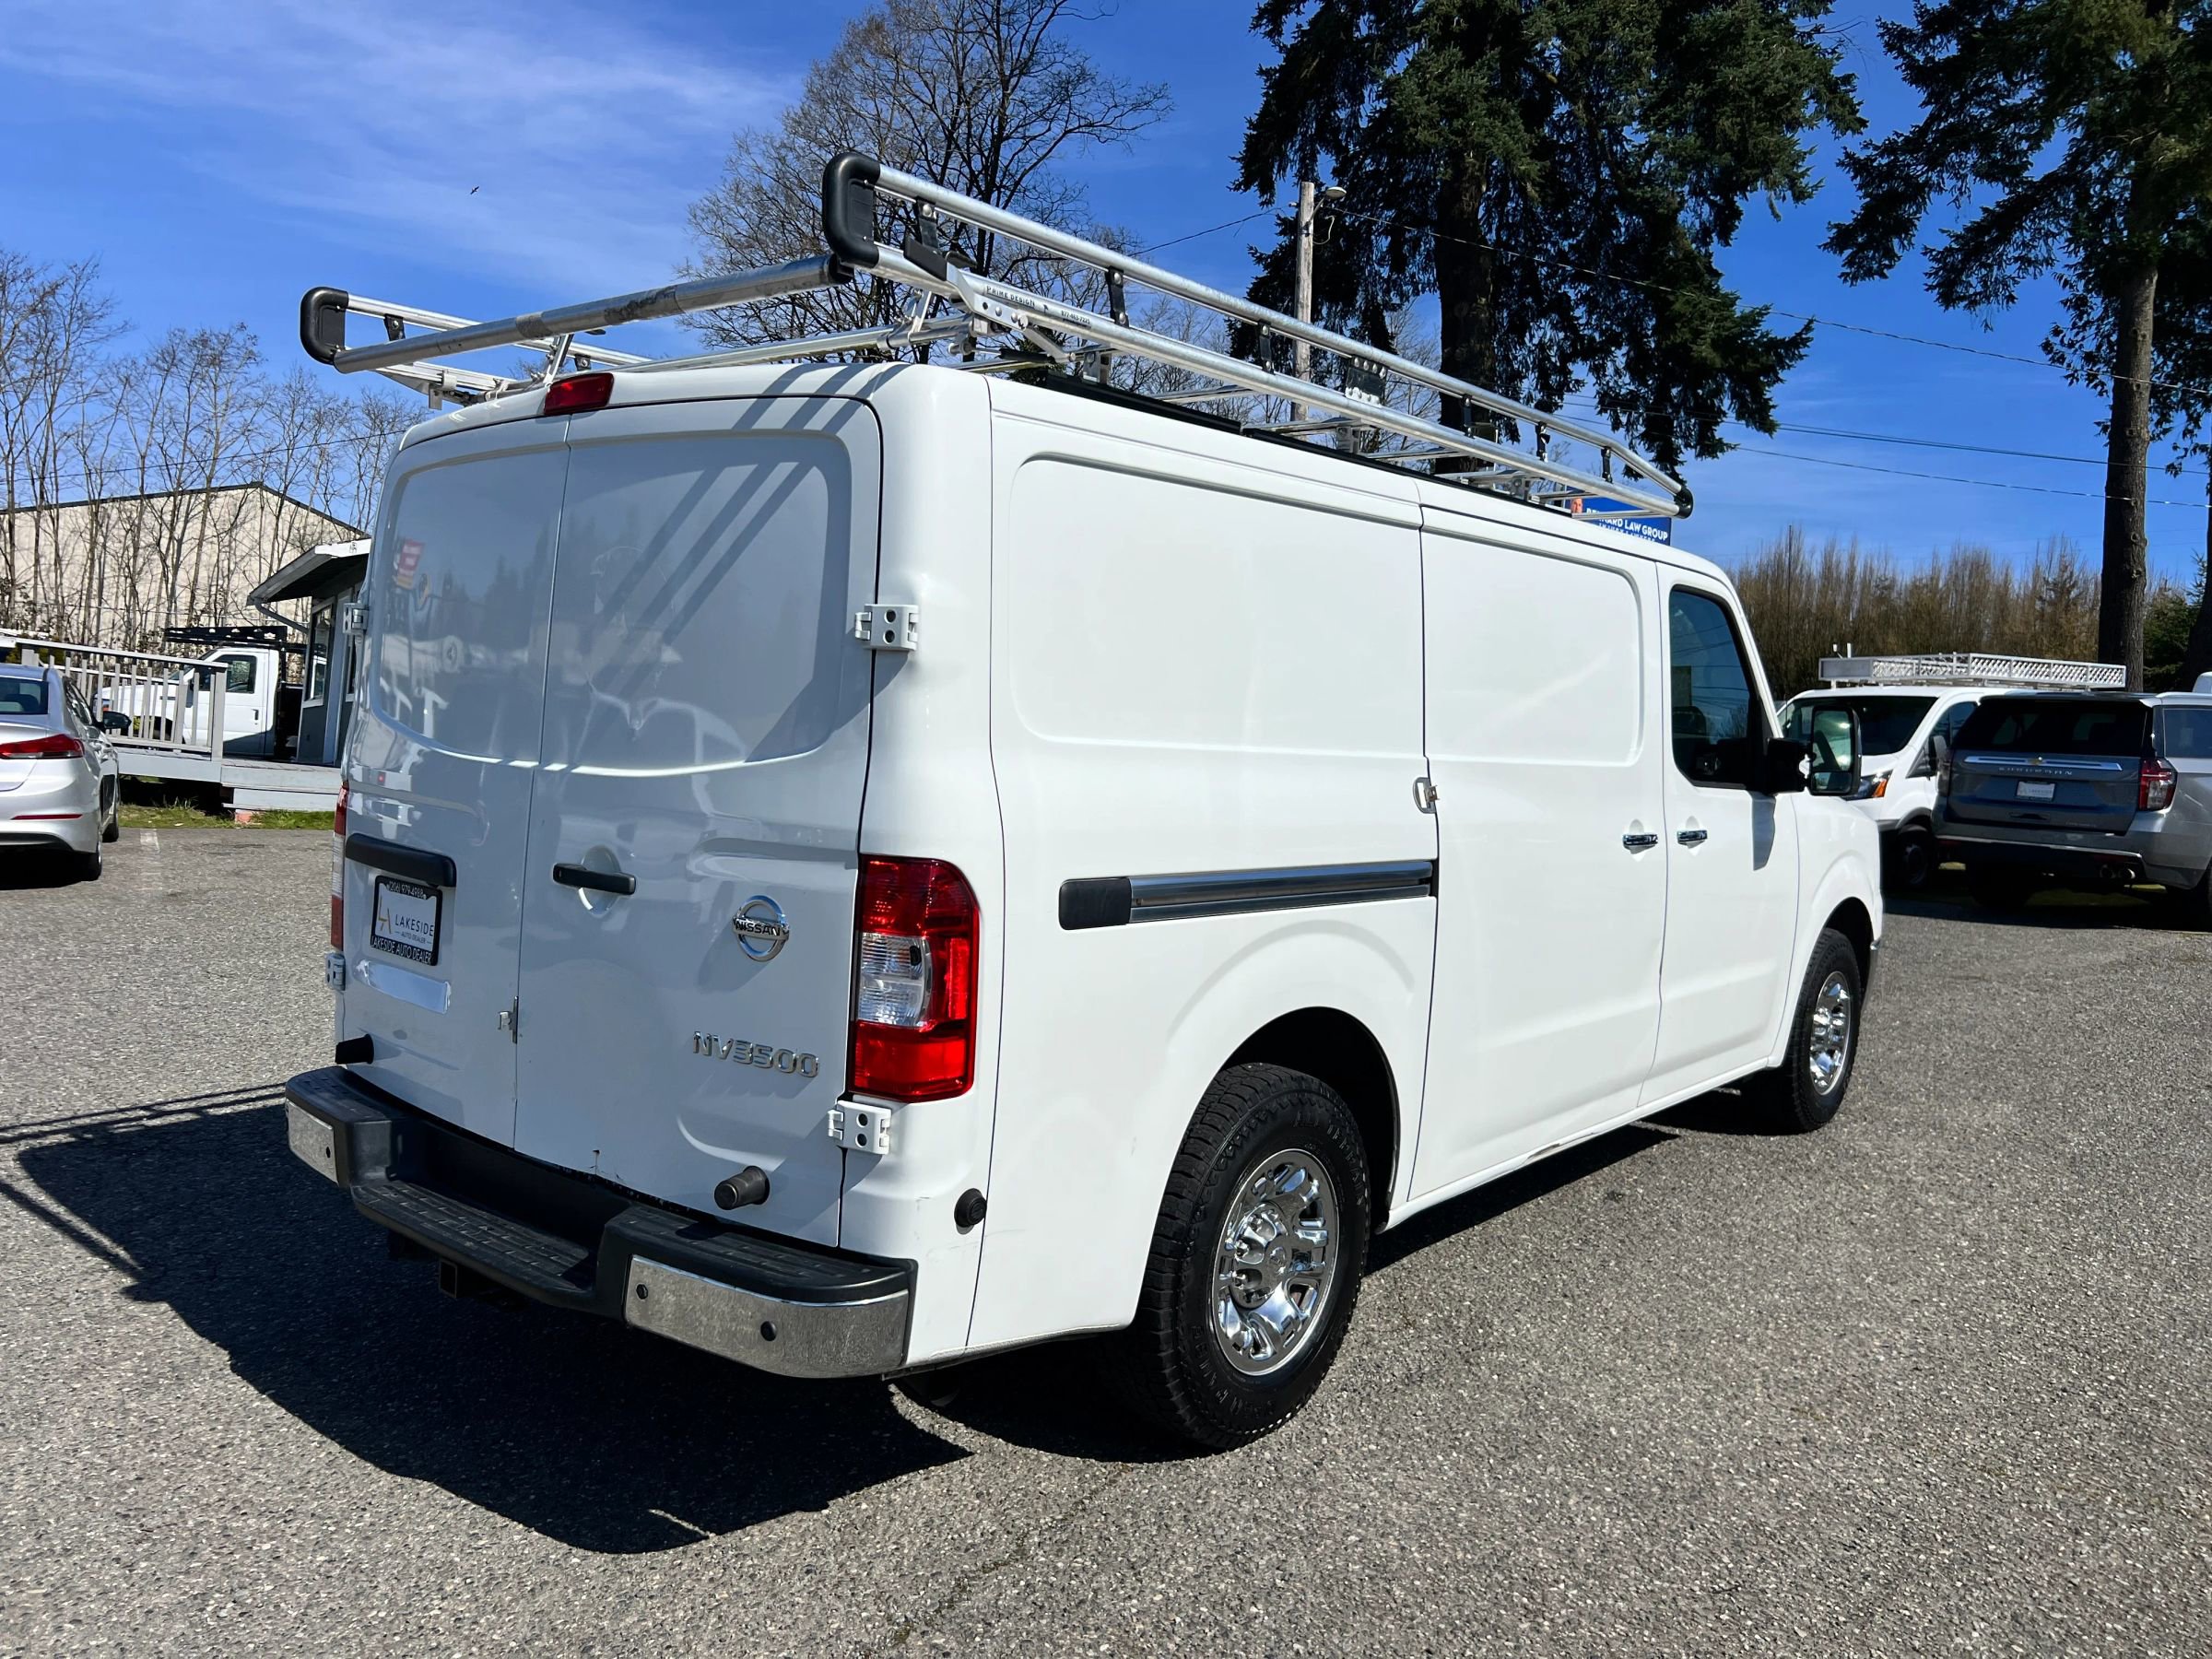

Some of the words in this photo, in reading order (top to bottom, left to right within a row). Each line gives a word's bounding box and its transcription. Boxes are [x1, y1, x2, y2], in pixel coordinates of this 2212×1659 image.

[986, 285, 1008, 298] PRIME
[1010, 294, 1035, 307] DESIGN
[1625, 520, 1641, 533] LAW
[1641, 524, 1668, 541] GROUP
[394, 914, 434, 936] LAKESIDE
[735, 920, 781, 936] NISSAN
[371, 935, 395, 953] LAKESIDE
[395, 944, 412, 959] AUTO
[412, 947, 431, 964] DEALER
[693, 1030, 819, 1078] NV3500
